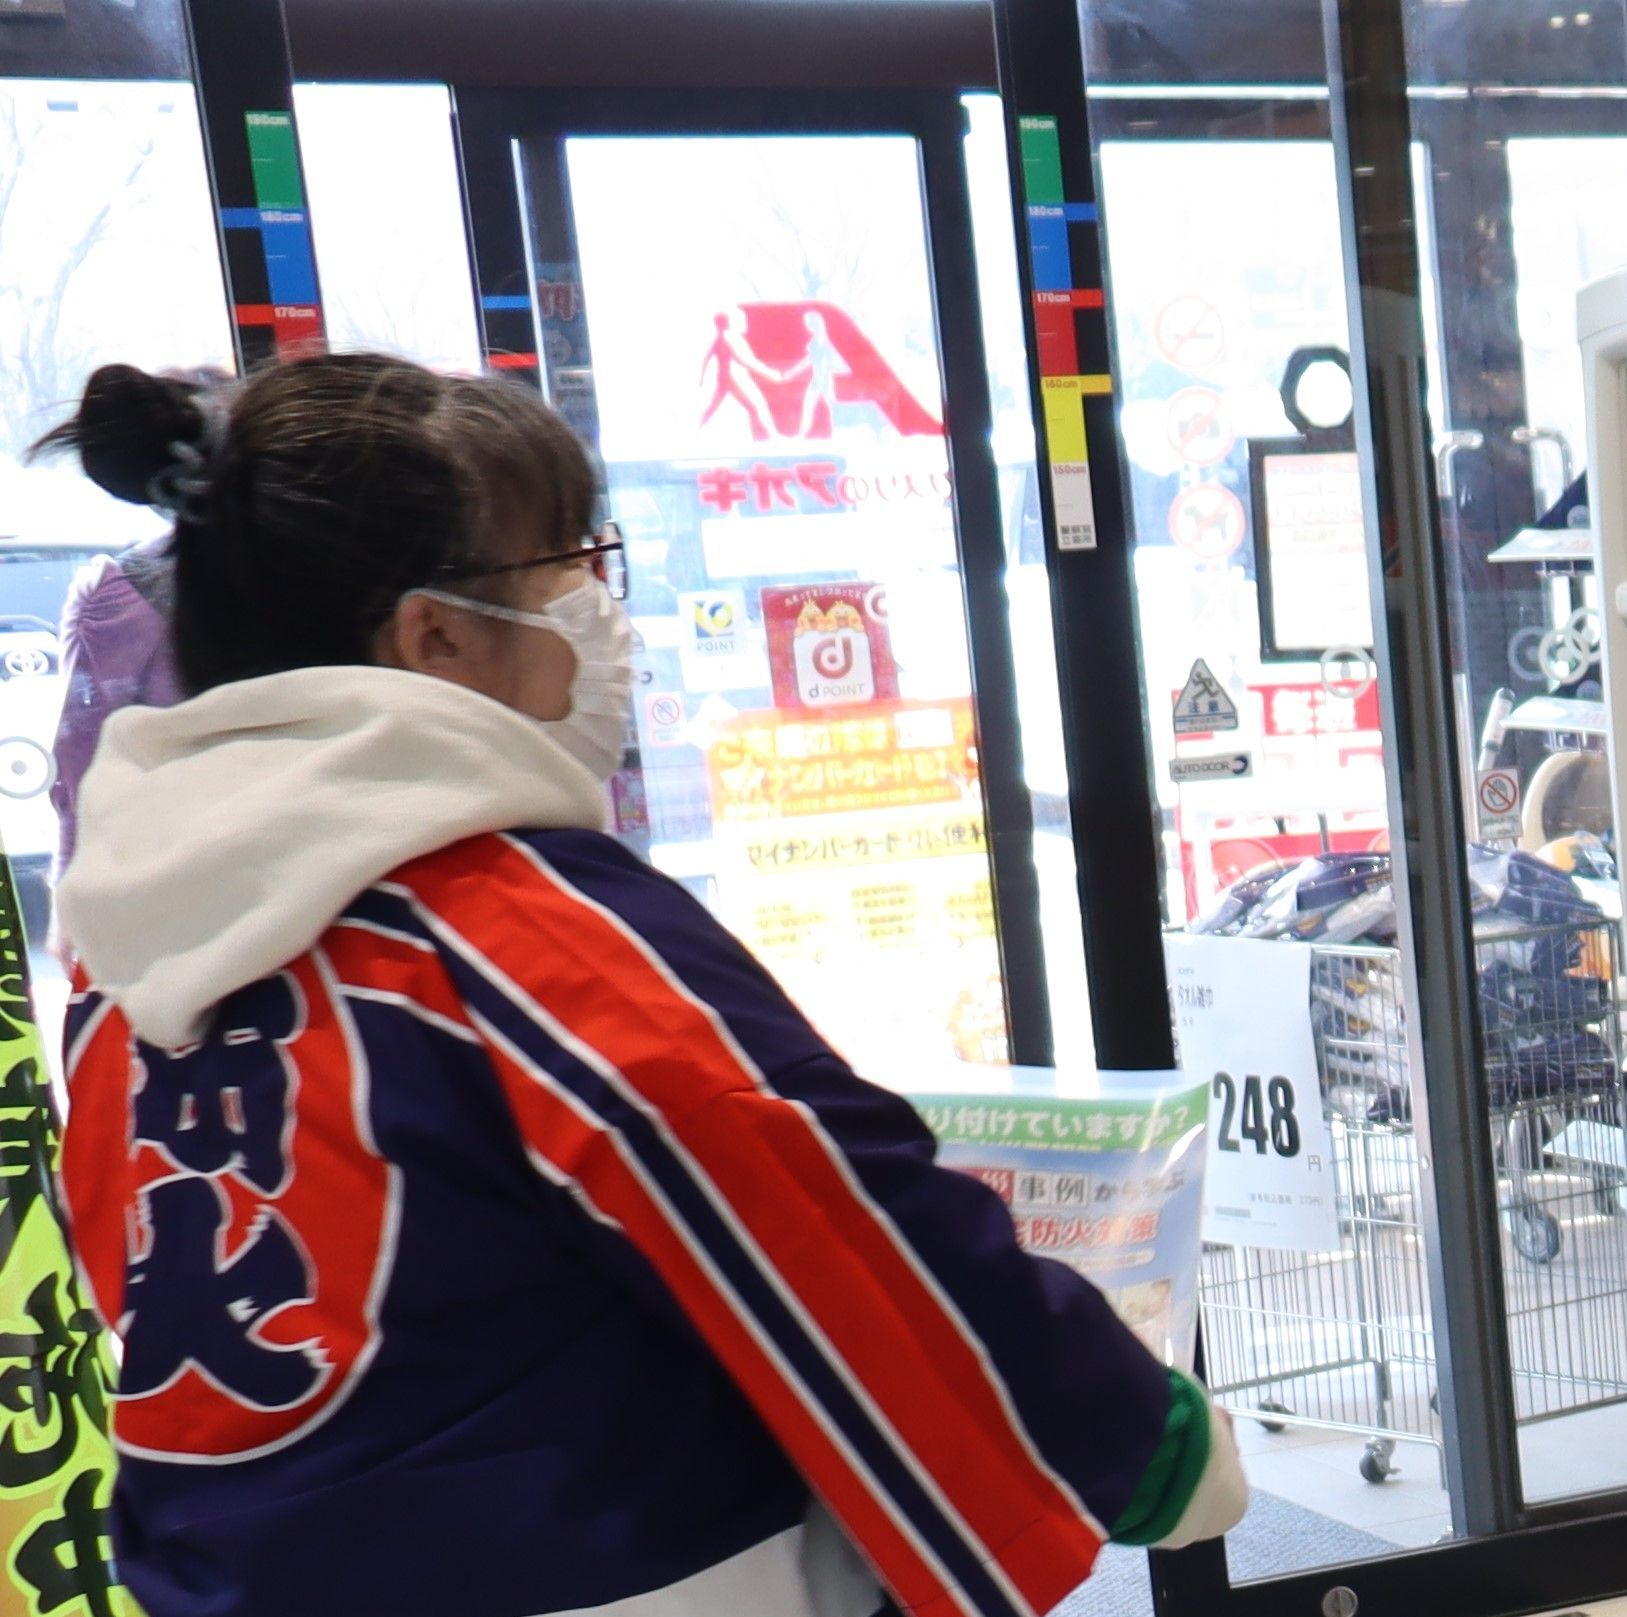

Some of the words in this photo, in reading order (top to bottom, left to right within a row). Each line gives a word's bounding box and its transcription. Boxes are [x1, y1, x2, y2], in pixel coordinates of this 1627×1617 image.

[1028, 205, 1064, 216] 180cm
[1036, 293, 1071, 303] 170cm
[274, 306, 317, 318] 170cm
[1044, 379, 1079, 390] 160cm
[1053, 465, 1087, 476] 150cm
[823, 683, 865, 697] POINT
[1213, 1071, 1301, 1159] 248
[1308, 1155, 1322, 1173] 円
